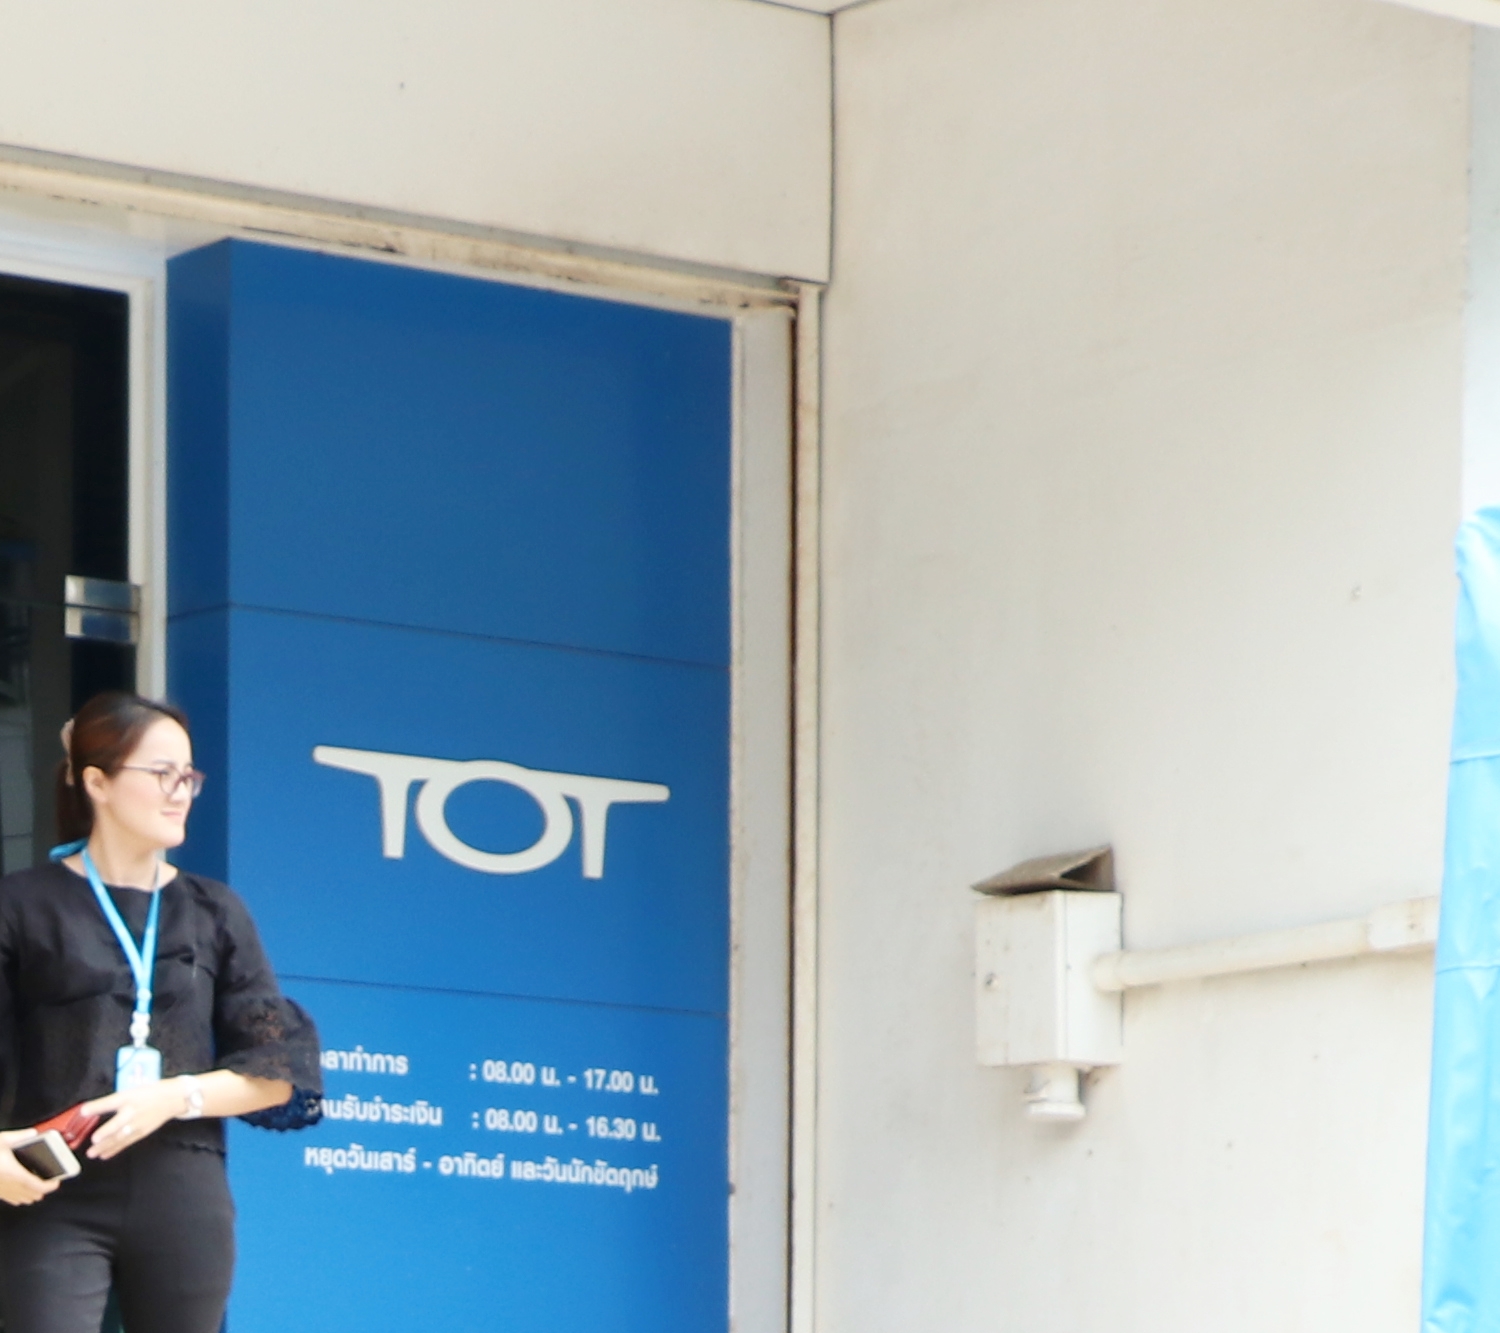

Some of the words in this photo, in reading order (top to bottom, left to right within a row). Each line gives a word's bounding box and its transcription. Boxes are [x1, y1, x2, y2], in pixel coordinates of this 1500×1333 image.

[311, 744, 671, 879] TOT
[319, 1045, 409, 1076] ลาทำการ
[482, 1060, 535, 1085] 08.00
[583, 1068, 634, 1093] 17.00
[484, 1108, 538, 1133] 08.00
[585, 1116, 637, 1141] 16.30
[304, 1142, 417, 1176] หยุดวันเสาร์
[438, 1151, 504, 1179] อาทิตย์
[510, 1155, 659, 1193] และวันนักขัตฤกษ์
